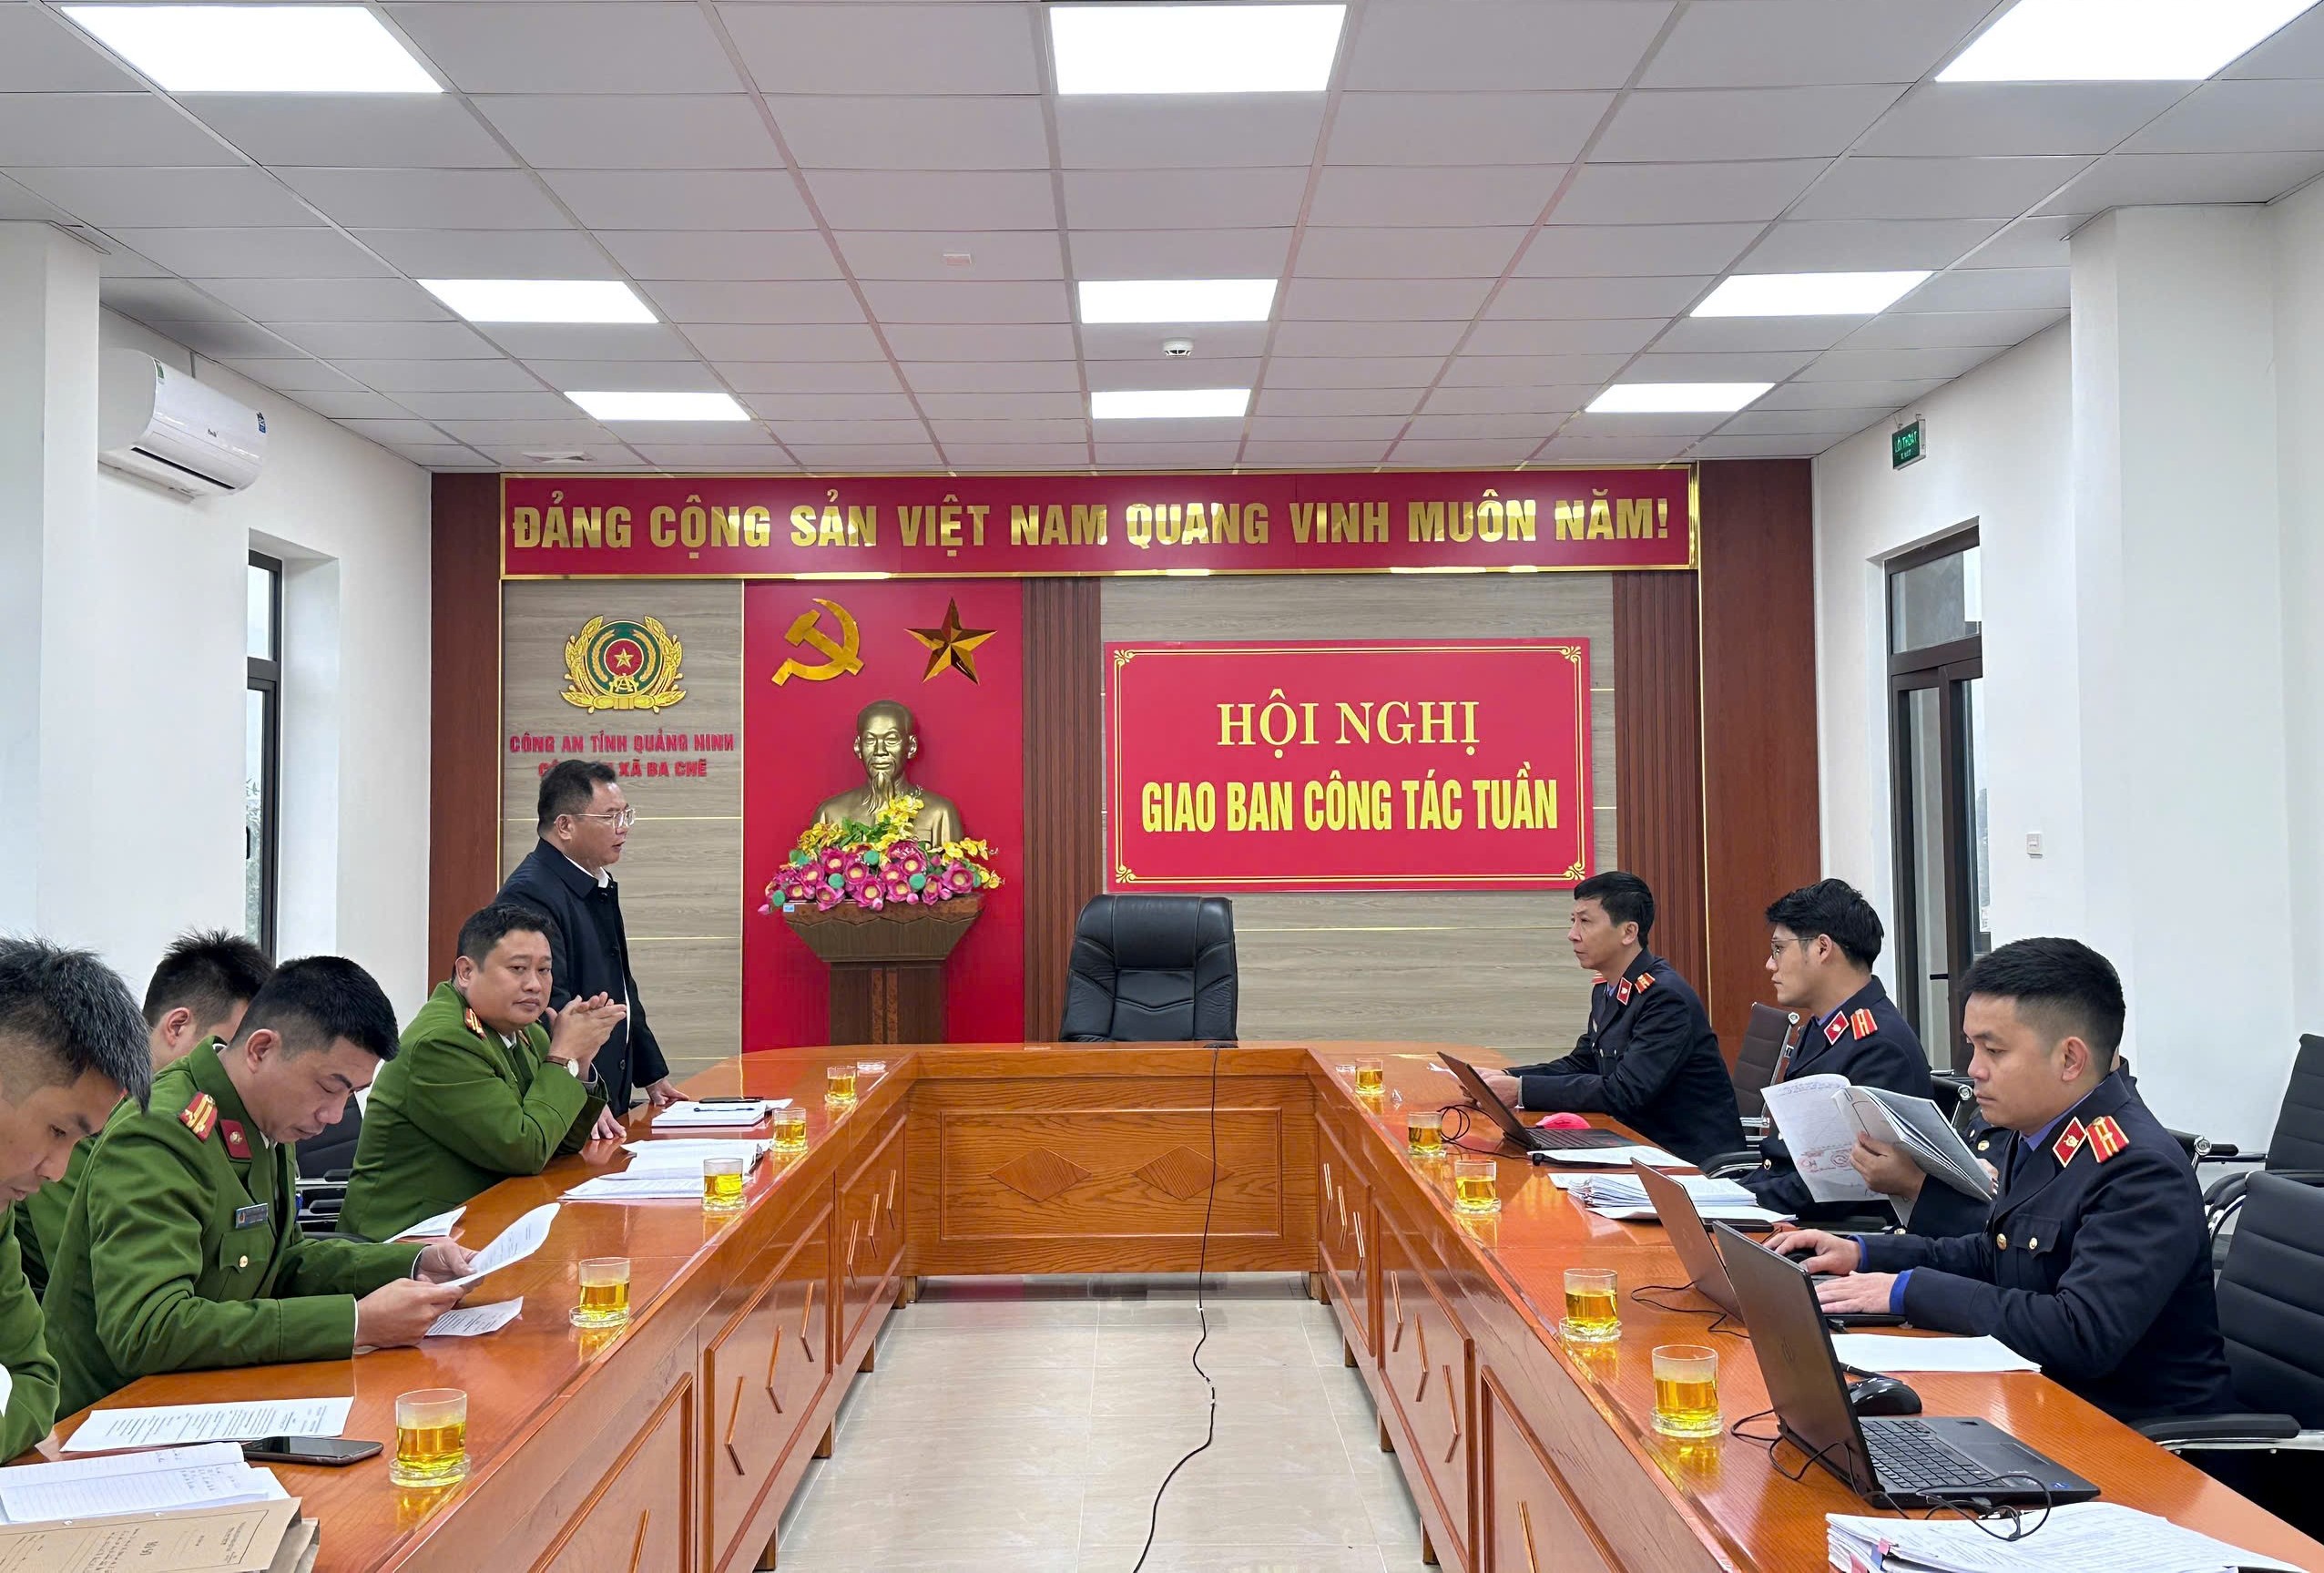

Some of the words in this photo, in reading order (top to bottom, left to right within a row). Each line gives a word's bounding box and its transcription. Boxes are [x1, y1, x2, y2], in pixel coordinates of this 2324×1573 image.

[513, 491, 631, 548] ĐẢNG
[649, 495, 772, 559] CỘNG
[789, 489, 877, 548] SẢN
[897, 495, 990, 557] VIỆT
[1010, 505, 1108, 546] NAM
[1126, 501, 1269, 550] QUANG
[1289, 501, 1390, 544] VINH
[1408, 489, 1536, 543] MUÔN
[1554, 489, 1668, 540] NĂM!
[510, 731, 555, 753] CÔNG
[561, 735, 585, 752] AN
[590, 730, 627, 753] TỈNH
[634, 728, 688, 753] QUẢNG
[694, 733, 735, 751] NINH
[1217, 689, 1320, 759] HỘI
[1335, 700, 1480, 756] NGHỊ
[619, 759, 643, 777] XÃ
[647, 761, 670, 777] BA
[675, 759, 707, 777] CHẼ
[1141, 782, 1216, 832] GIAO
[1227, 781, 1293, 832] BAN
[1303, 771, 1392, 832] CÔNG
[1402, 769, 1463, 830] TÁC
[1472, 762, 1558, 830] TUẦN
